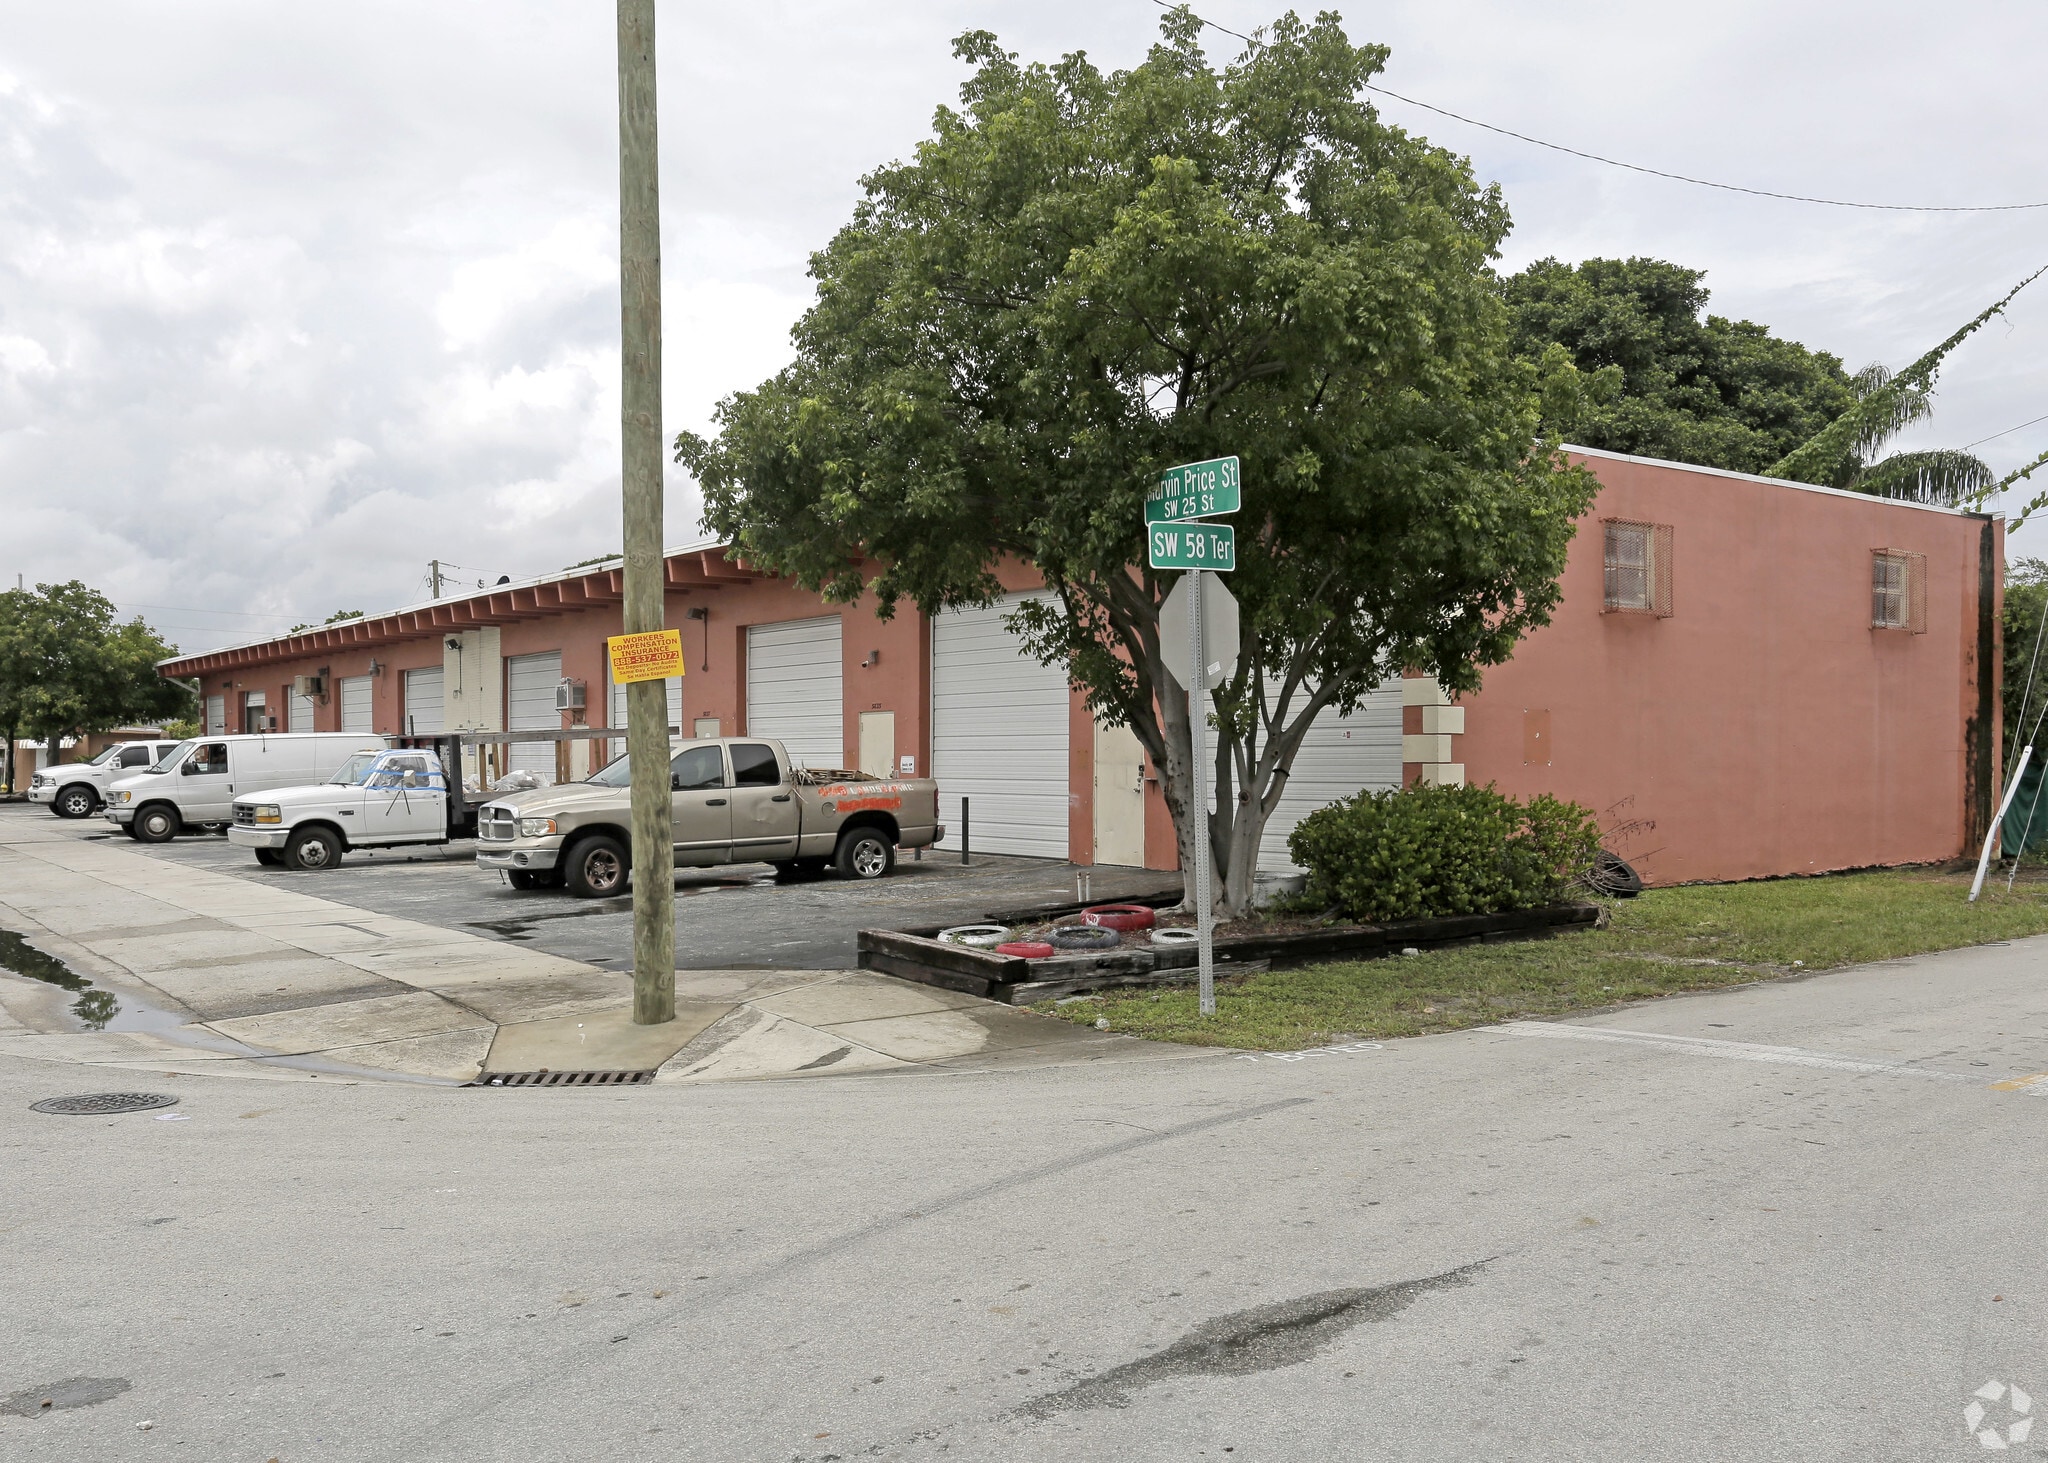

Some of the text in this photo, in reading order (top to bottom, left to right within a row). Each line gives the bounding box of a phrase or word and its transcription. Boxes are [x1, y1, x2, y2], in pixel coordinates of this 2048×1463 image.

[1184, 467, 1216, 495] Price
[1221, 461, 1236, 488] St
[1164, 494, 1214, 518] SW 25 St
[1154, 532, 1230, 559] SW 58 Ter
[611, 638, 678, 652] COMPENSATION
[622, 633, 665, 644] WORKERS
[621, 645, 670, 657] INSURANCE
[614, 651, 679, 666] 888-537-0072
[635, 667, 646, 675] Day
[646, 664, 677, 672] Certificates
[650, 669, 671, 677] Espanol
